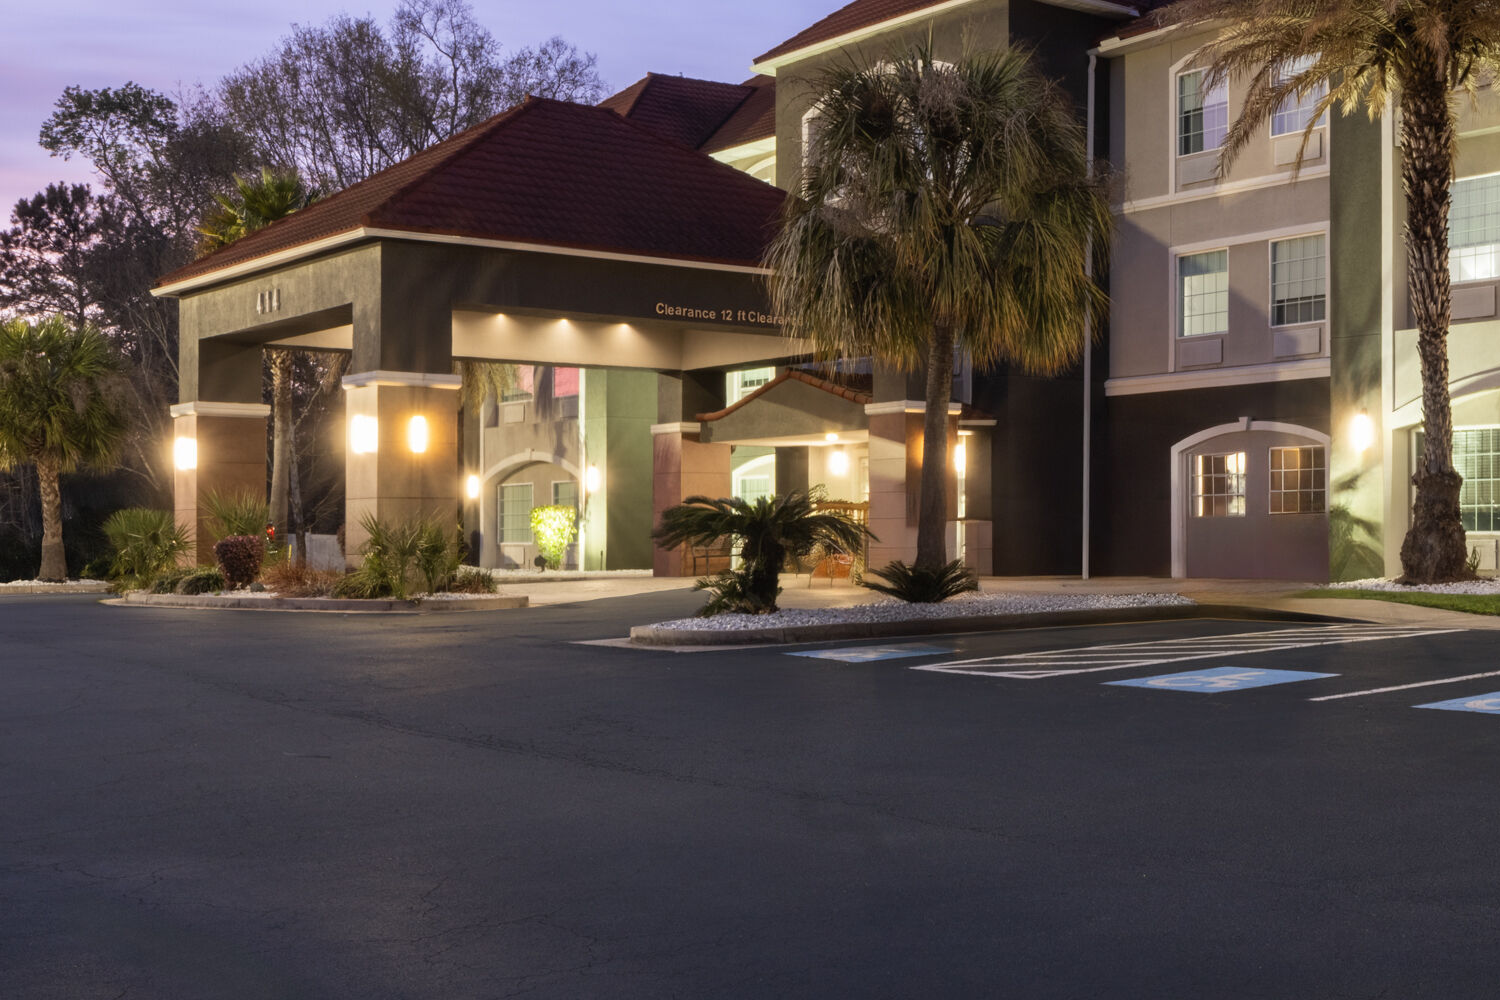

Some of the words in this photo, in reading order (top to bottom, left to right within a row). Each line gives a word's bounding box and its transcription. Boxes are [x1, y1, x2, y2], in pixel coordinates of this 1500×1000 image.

[655, 302, 716, 320] Clearance
[720, 309, 733, 321] 12
[737, 310, 747, 321] ft
[747, 311, 803, 327] Cleara
